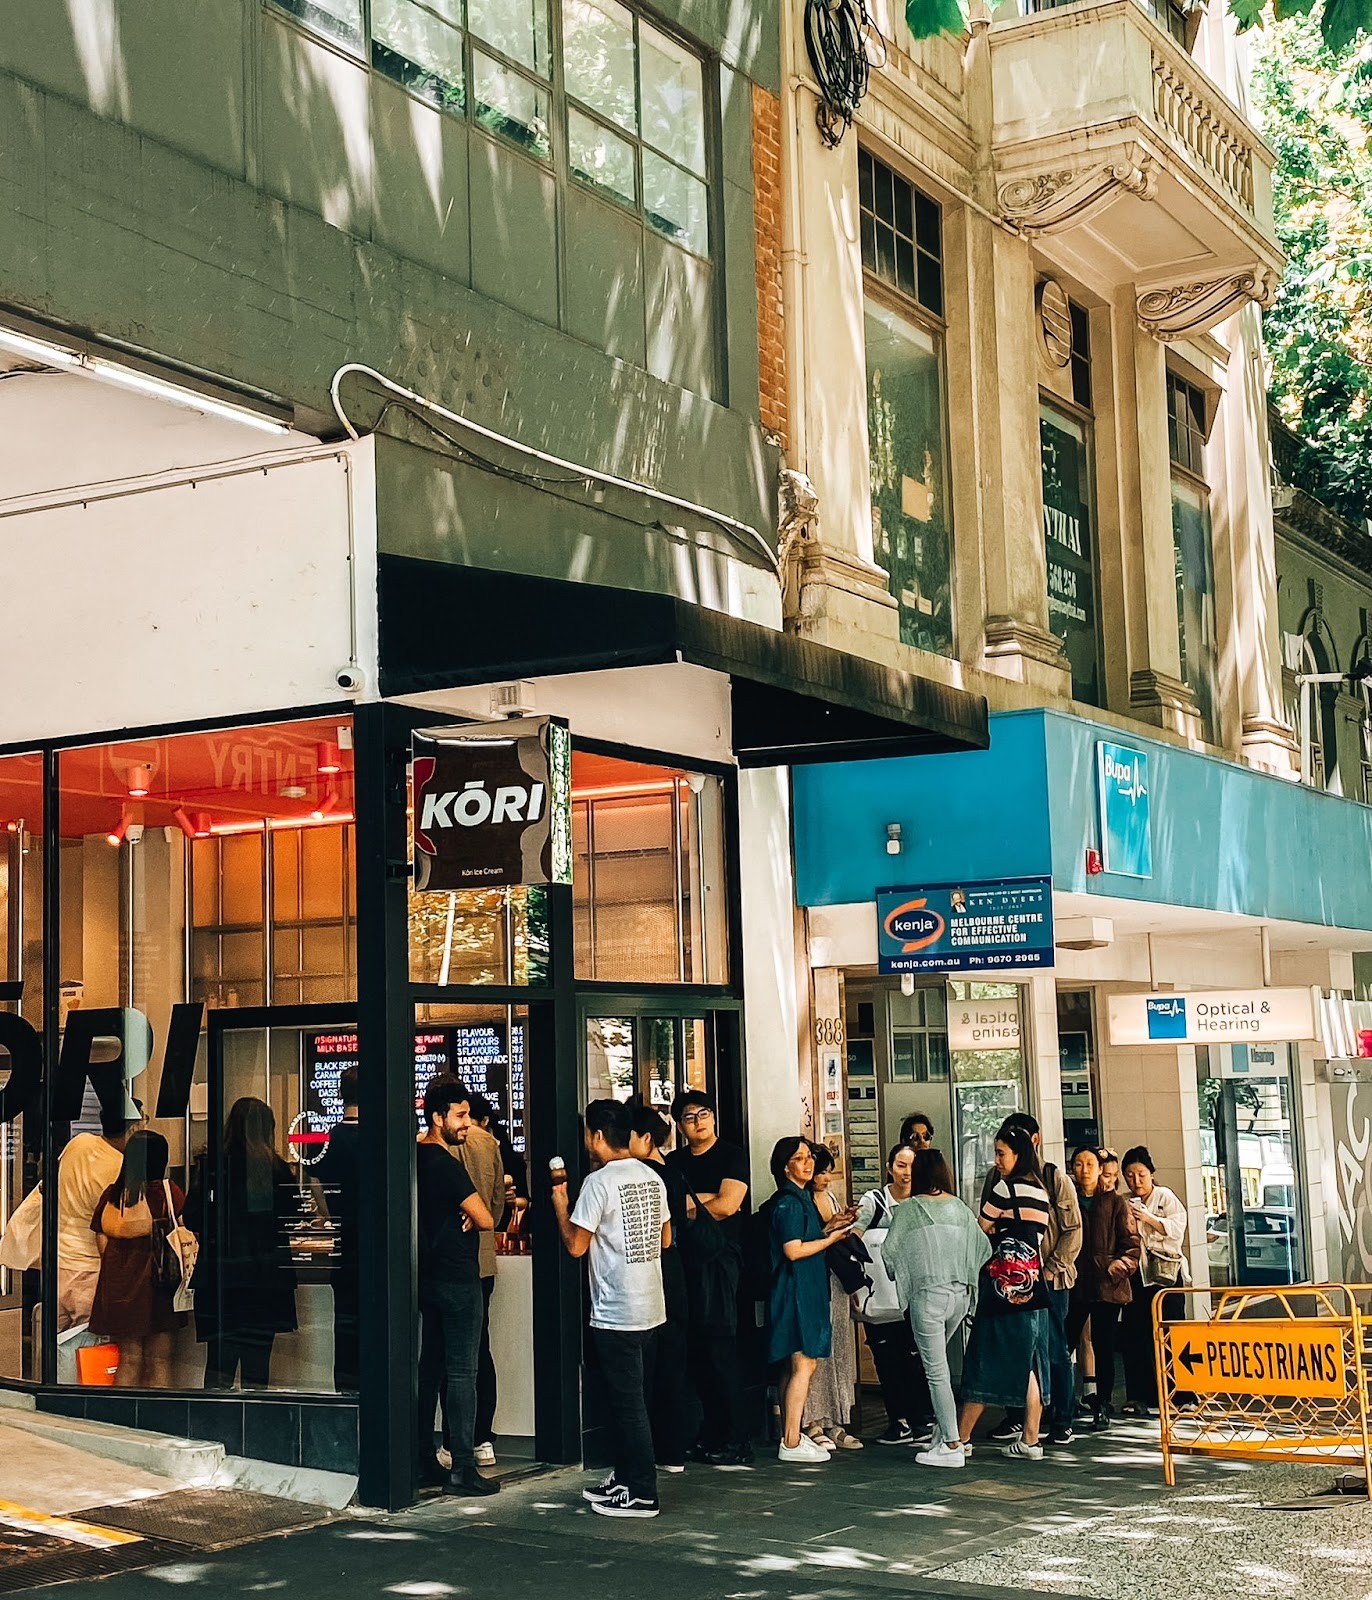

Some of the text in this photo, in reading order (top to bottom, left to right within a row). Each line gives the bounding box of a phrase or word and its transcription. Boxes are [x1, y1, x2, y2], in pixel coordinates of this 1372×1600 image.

[1105, 755, 1131, 785] Bupa
[420, 780, 544, 830] KŌRI
[483, 867, 504, 876] Cream
[969, 895, 1043, 906] KEN DYERS
[894, 918, 935, 932] kenja
[950, 913, 1043, 928] MELBOURNE CENTRE
[950, 925, 1018, 937] FOR EFFECTIVE
[951, 933, 1027, 946] COMMUNICATION
[890, 957, 960, 969] kenja.com.au
[1147, 1001, 1170, 1011] Bupa
[1196, 1000, 1271, 1018] Optical &
[1197, 1017, 1260, 1032] Hearing
[461, 1028, 494, 1037] FLAVOUR
[462, 1037, 499, 1046] FLAVOURS
[316, 1044, 335, 1053] MILK
[462, 1046, 500, 1056] FLAVOURS
[314, 1061, 338, 1071] BLACK
[472, 1064, 487, 1074] TUB
[472, 1073, 487, 1083] TUB
[309, 1080, 337, 1089] COFFEE
[473, 1083, 487, 1092] TUB
[1206, 1340, 1338, 1383] PEDESTRIANS
